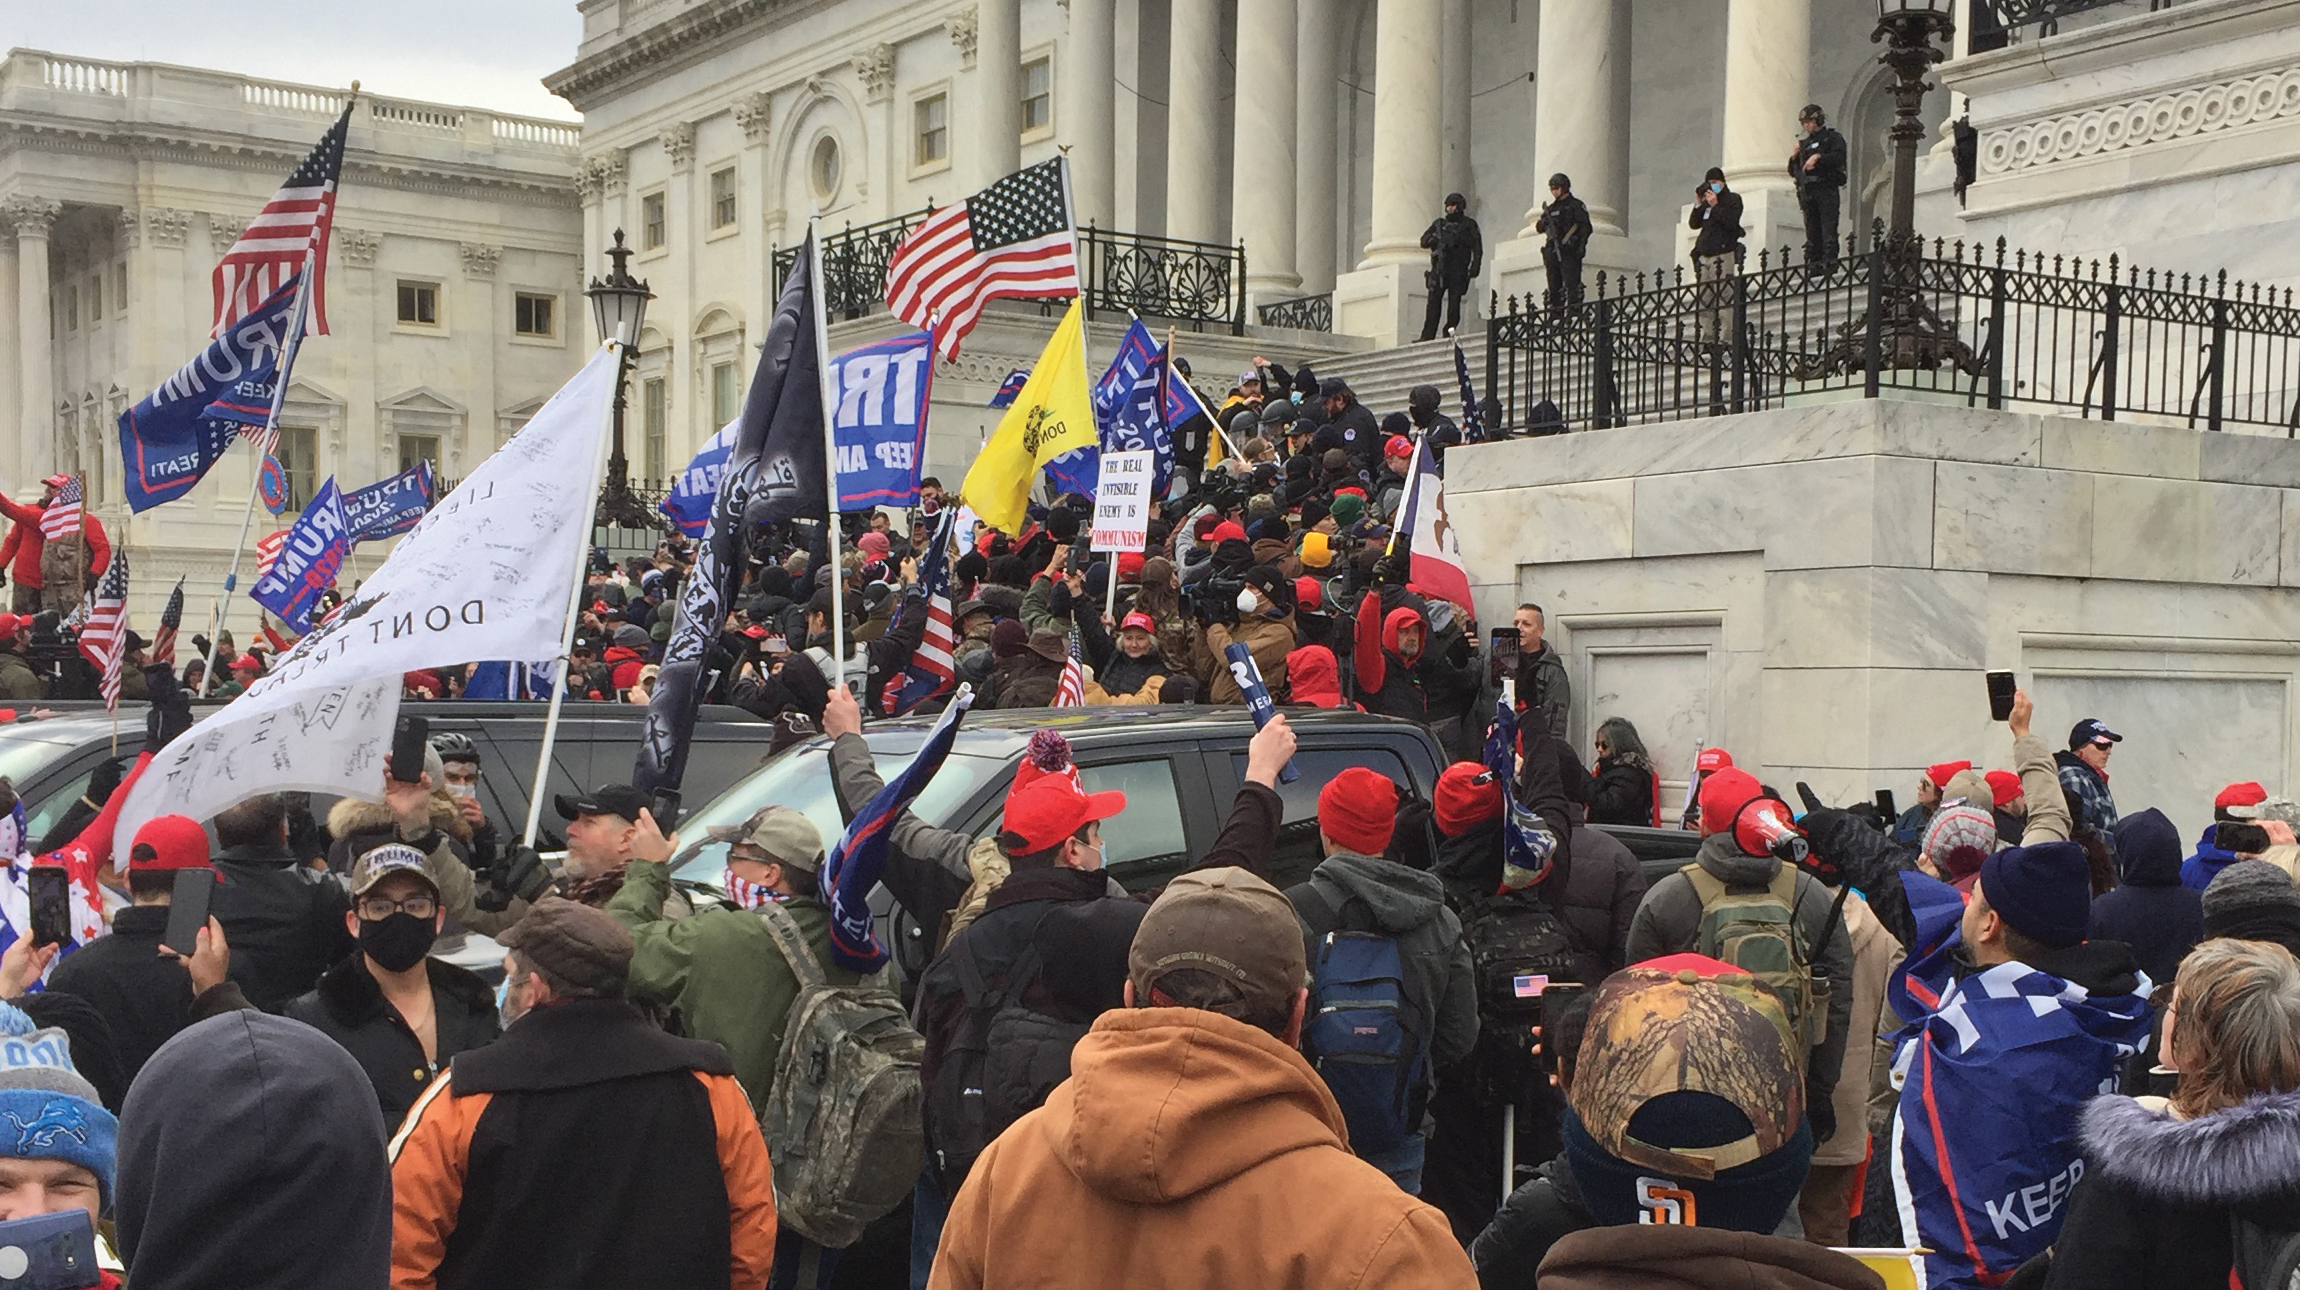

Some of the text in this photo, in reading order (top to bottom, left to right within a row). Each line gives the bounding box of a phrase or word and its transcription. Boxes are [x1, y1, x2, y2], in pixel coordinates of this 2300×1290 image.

[1105, 459, 1143, 474] THE REAL
[1102, 482, 1139, 497] INVISIBLE
[1098, 504, 1122, 518] ENEMY
[1127, 504, 1137, 518] IS
[1091, 529, 1145, 547] COMMUNISM
[364, 849, 424, 868] TRUMP
[1984, 1158, 2085, 1241] KEEP
